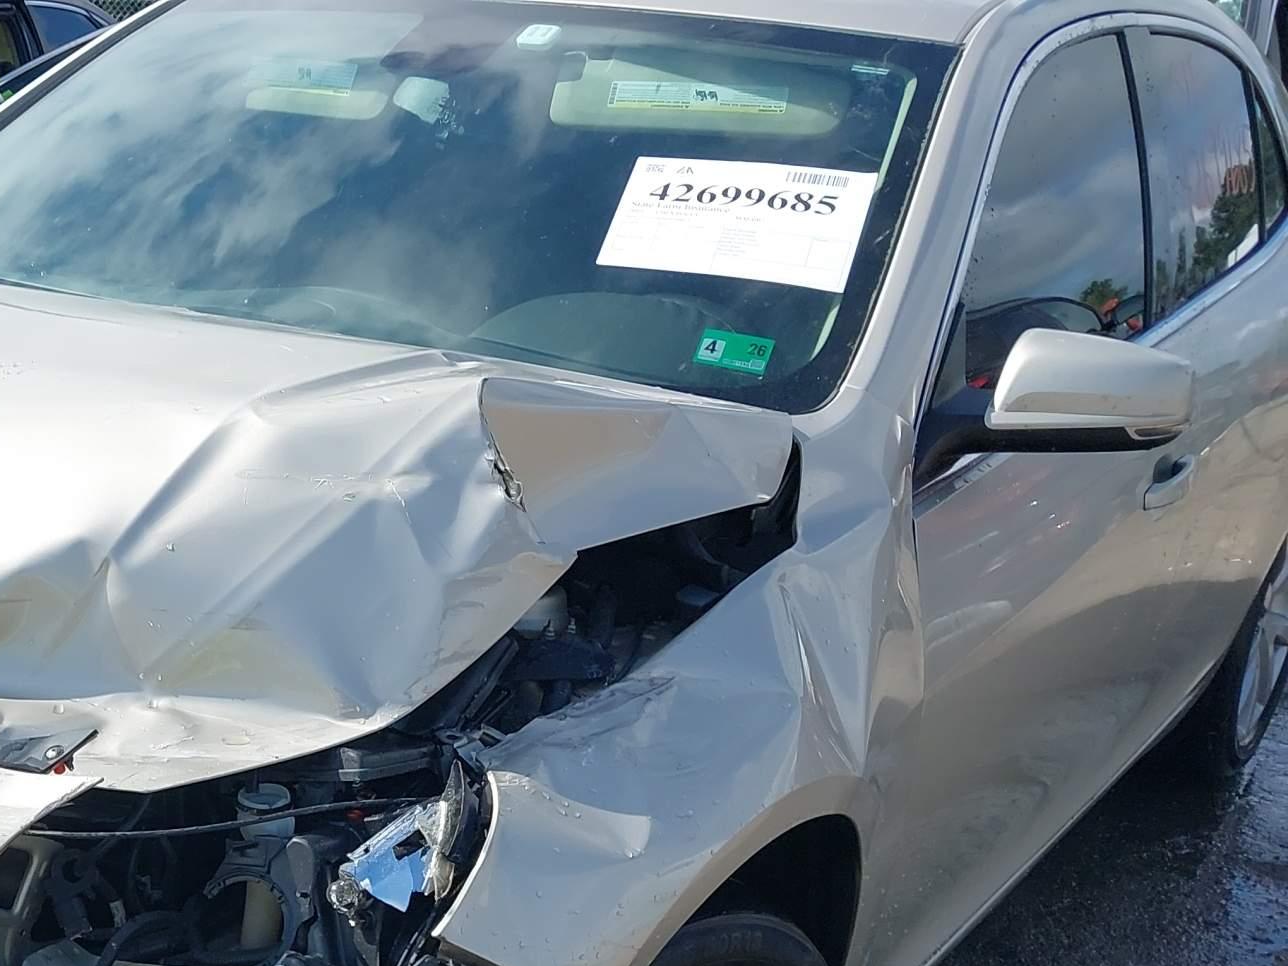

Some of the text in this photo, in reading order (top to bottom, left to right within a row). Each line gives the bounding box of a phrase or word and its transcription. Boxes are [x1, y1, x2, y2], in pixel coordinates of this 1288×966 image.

[649, 181, 840, 216] 42699685
[703, 339, 718, 355] 4
[747, 343, 768, 358] 26
